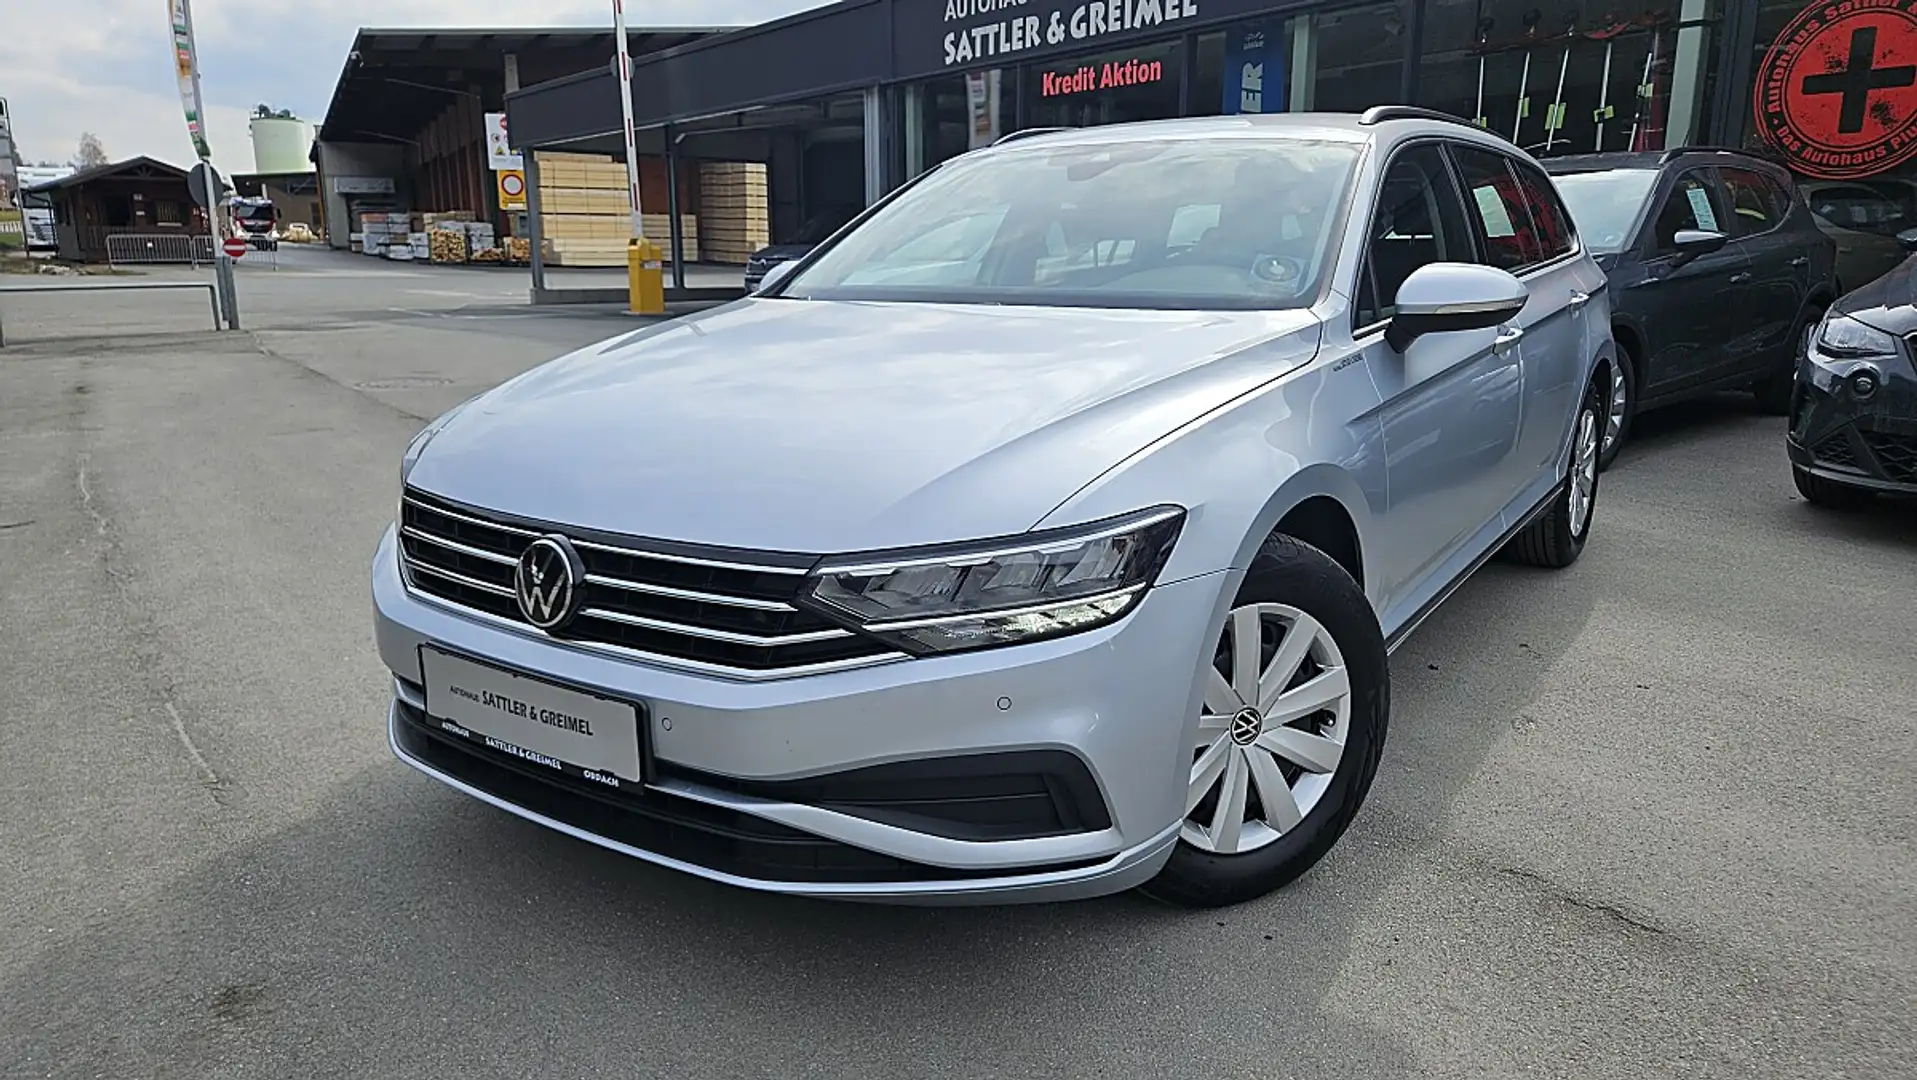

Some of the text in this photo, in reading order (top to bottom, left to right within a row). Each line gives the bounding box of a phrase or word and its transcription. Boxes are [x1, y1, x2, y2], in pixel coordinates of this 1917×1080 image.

[944, 0, 1197, 65] SATTLER & GREIMEL
[1042, 58, 1161, 97] Kredit Aktion
[1767, 19, 1820, 114] Autohaus
[1776, 123, 1917, 166] Das Autohaus Plu
[482, 690, 527, 719] SATTLER
[530, 705, 538, 721] &
[540, 709, 594, 736] GREIMEL
[485, 737, 519, 755] SATTLER
[525, 750, 562, 770] GREIMEL
